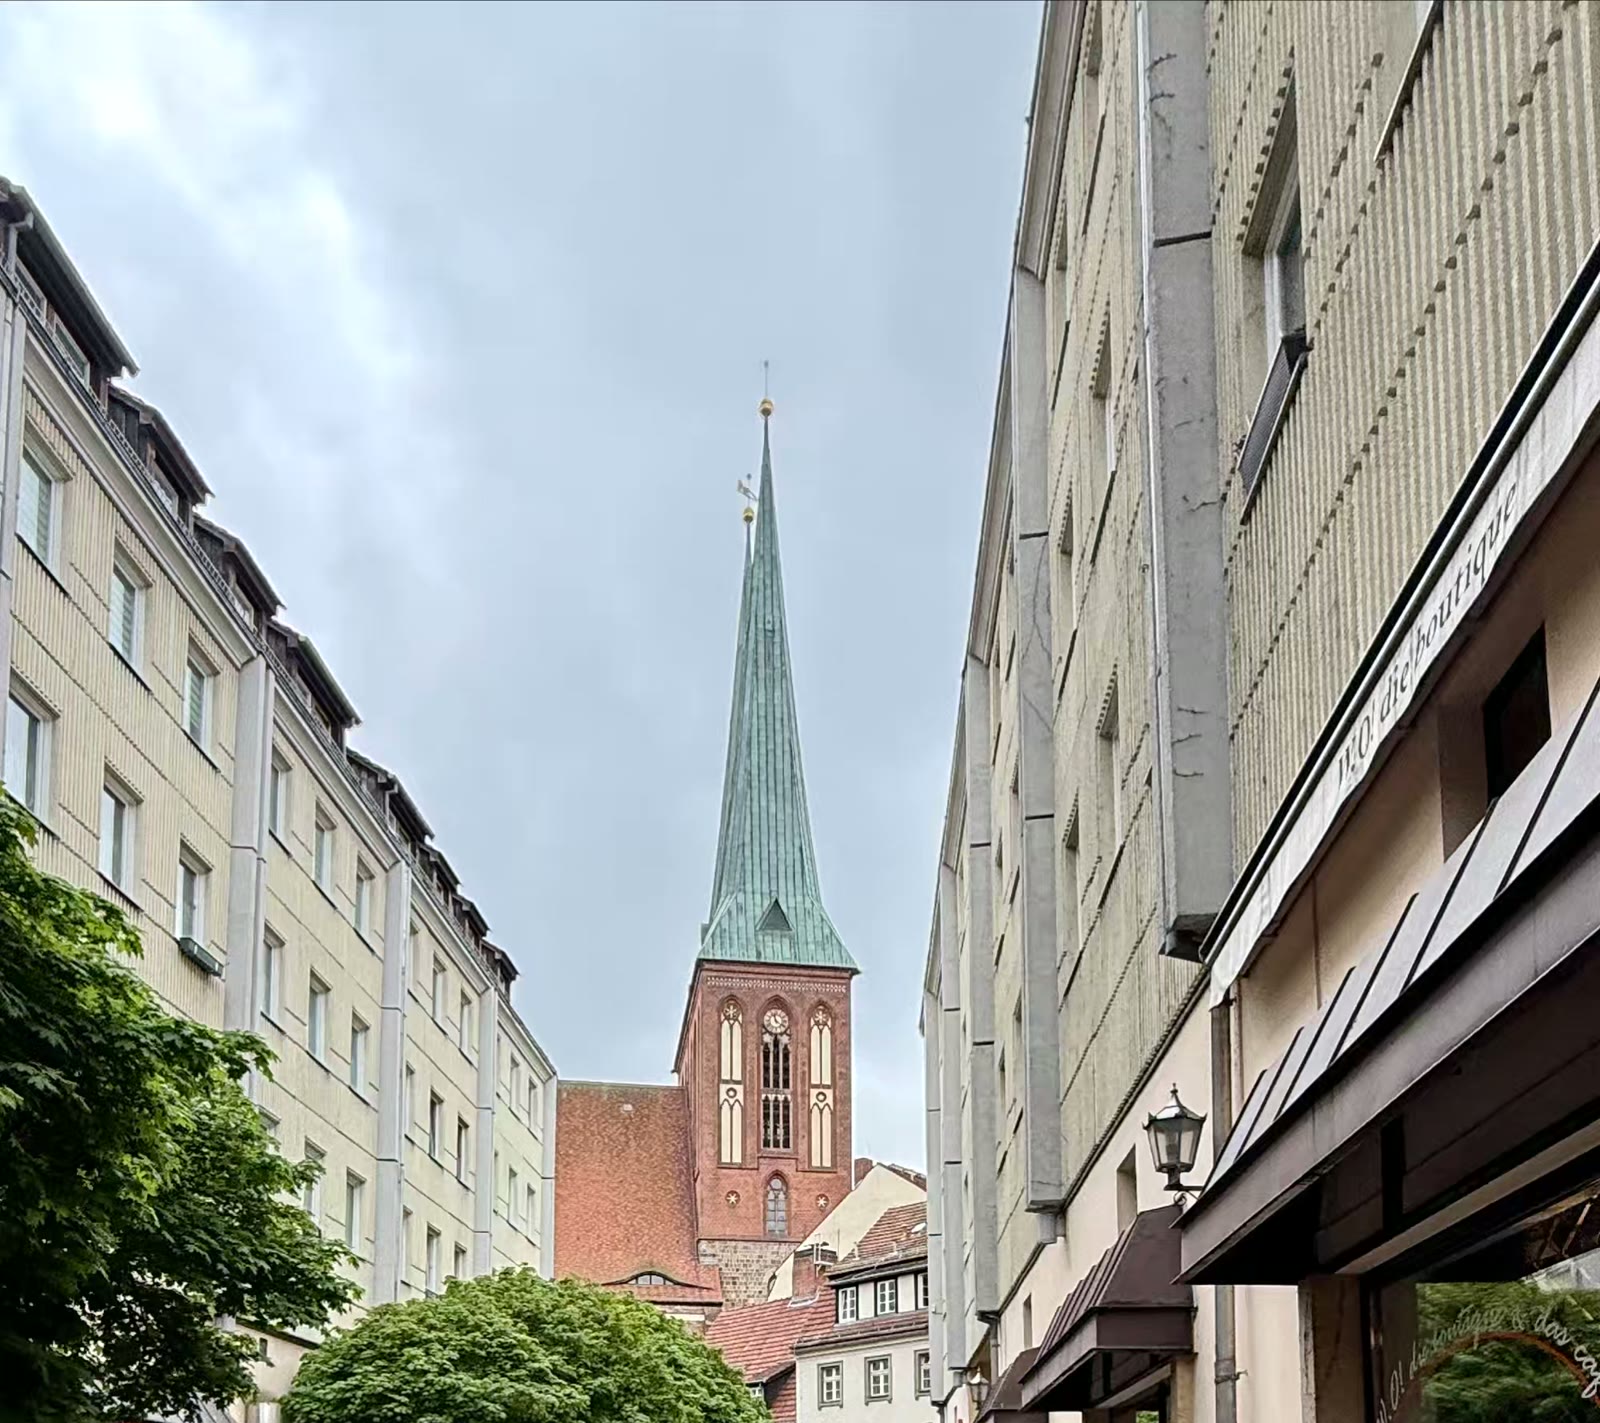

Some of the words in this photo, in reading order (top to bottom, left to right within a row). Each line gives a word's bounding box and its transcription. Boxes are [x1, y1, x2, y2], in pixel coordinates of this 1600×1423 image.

[1380, 663, 1409, 723] die
[1413, 482, 1517, 673] boutique
[1534, 1310, 1574, 1347] das
